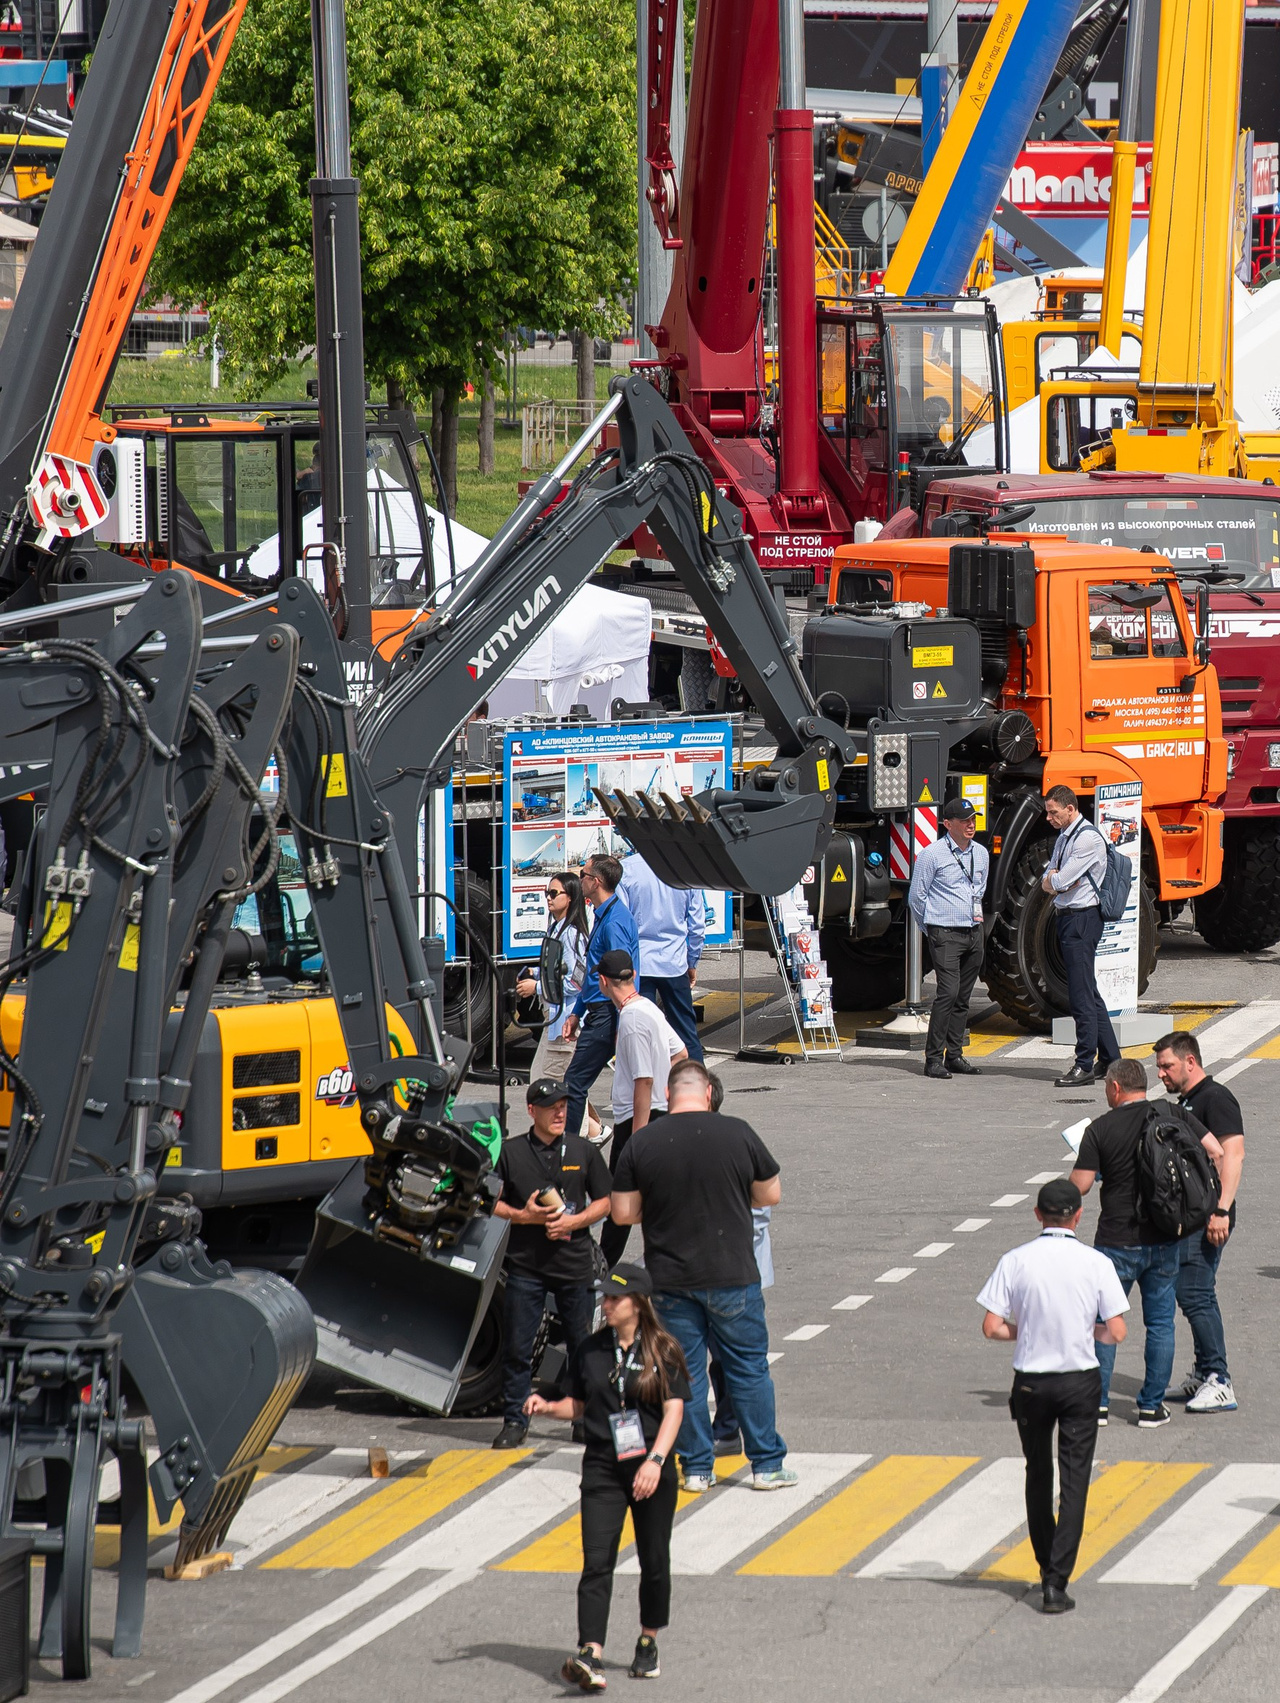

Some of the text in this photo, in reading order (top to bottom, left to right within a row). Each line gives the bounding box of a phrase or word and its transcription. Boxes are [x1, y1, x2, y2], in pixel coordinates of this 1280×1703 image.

[977, 12, 1014, 92] НЕ СТОЙ ПОД СТРЕЛОЙ
[1028, 517, 1256, 533] Изготовлен из высокопрочных сталей
[774, 534, 822, 546] НЕ СТОЙ
[760, 546, 835, 559] ПОД СТРЕЛОЙ
[1092, 695, 1192, 708] ПРОДАЖА АВТОКРАНОВ И КМУ:
[1114, 708, 1144, 718] МОСКВА
[1144, 707, 1161, 717] (495)
[1123, 719, 1145, 728] ГАЛИЧ
[531, 739, 542, 747] АО
[542, 734, 594, 746] «КЛИНЦОВСКИЙ
[594, 731, 648, 743] АВТОКРАНОВЫЙ
[648, 732, 675, 741] ЗАВОД»
[683, 734, 723, 743] КЛИНЦЫ
[1100, 783, 1142, 799] ГАЛИЧАНИН
[318, 1068, 354, 1096] B60
